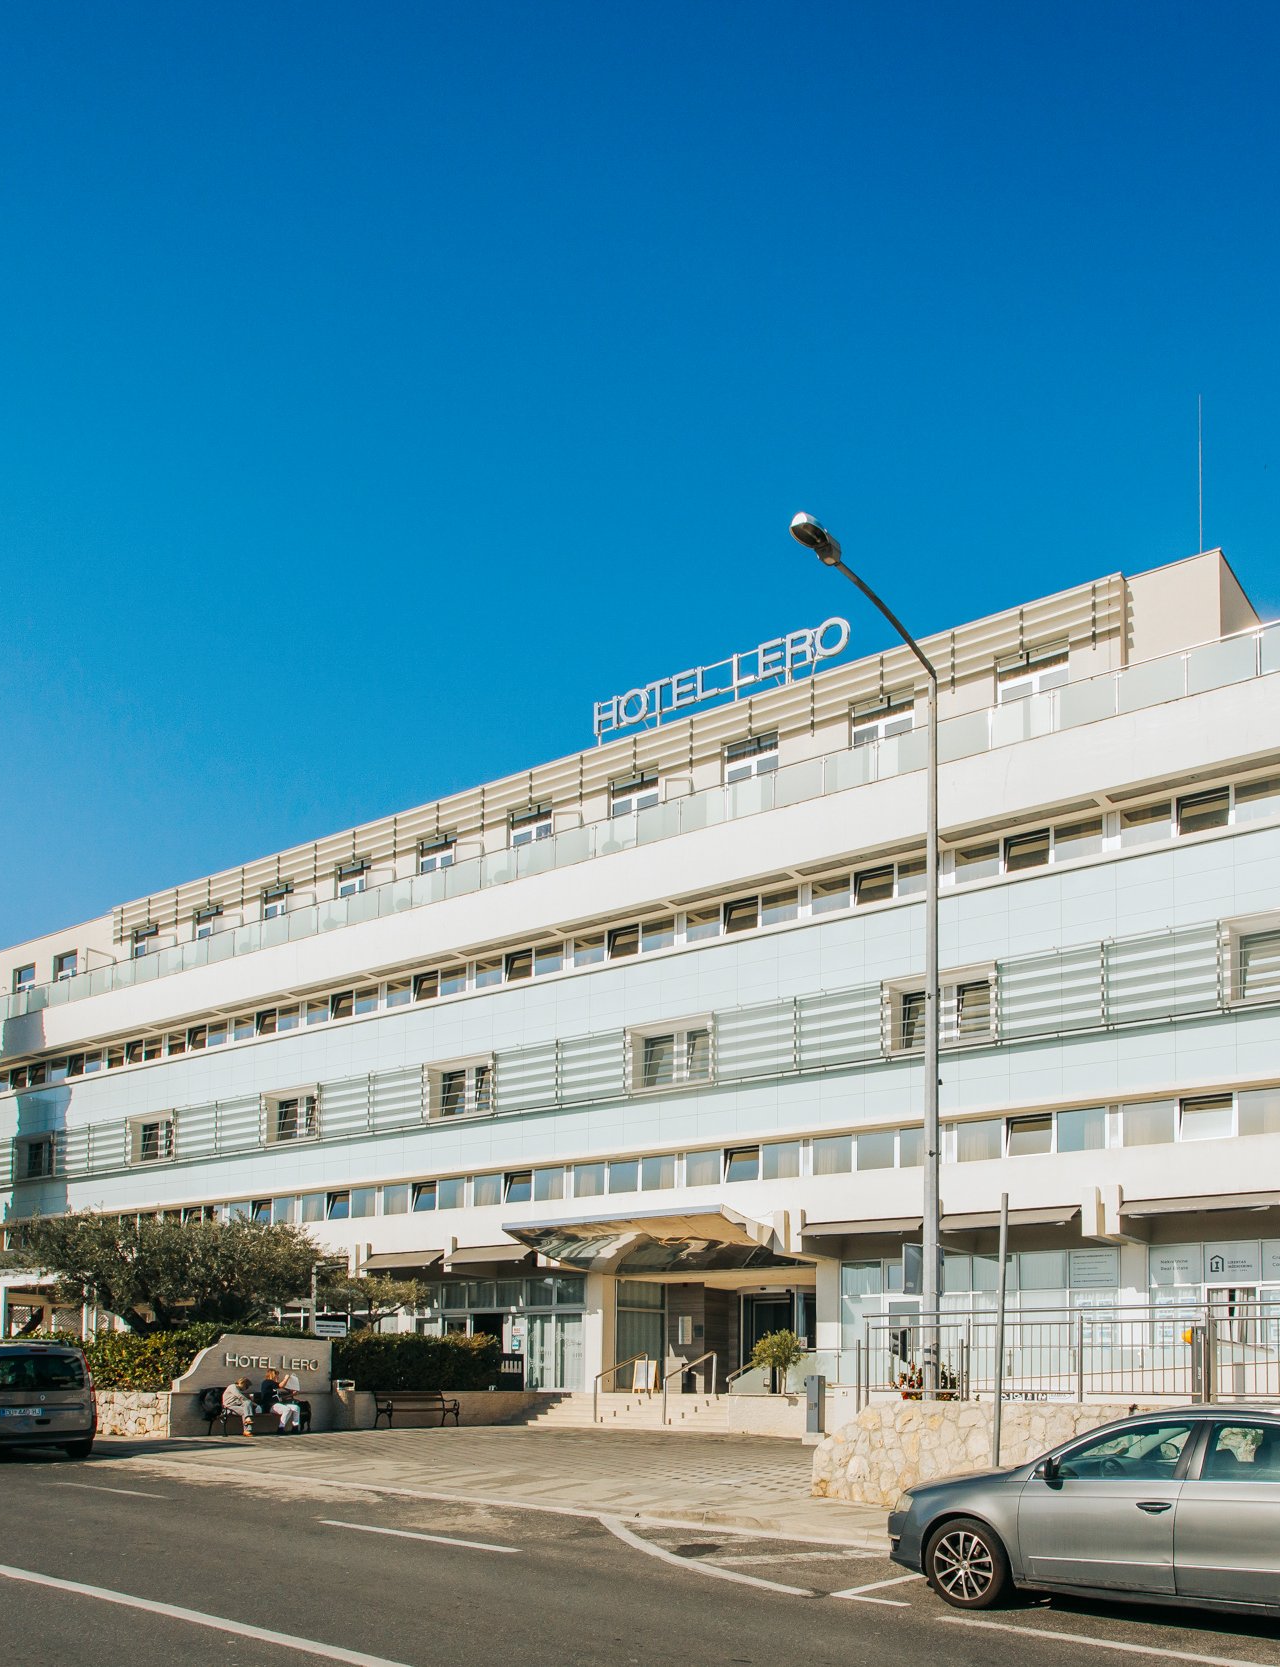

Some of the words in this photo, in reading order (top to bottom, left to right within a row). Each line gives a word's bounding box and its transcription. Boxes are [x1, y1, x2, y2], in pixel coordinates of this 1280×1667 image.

[593, 666, 718, 736] HOTEL
[732, 617, 851, 688] LERO
[225, 1353, 276, 1369] HOTEL
[282, 1355, 319, 1371] LERO
